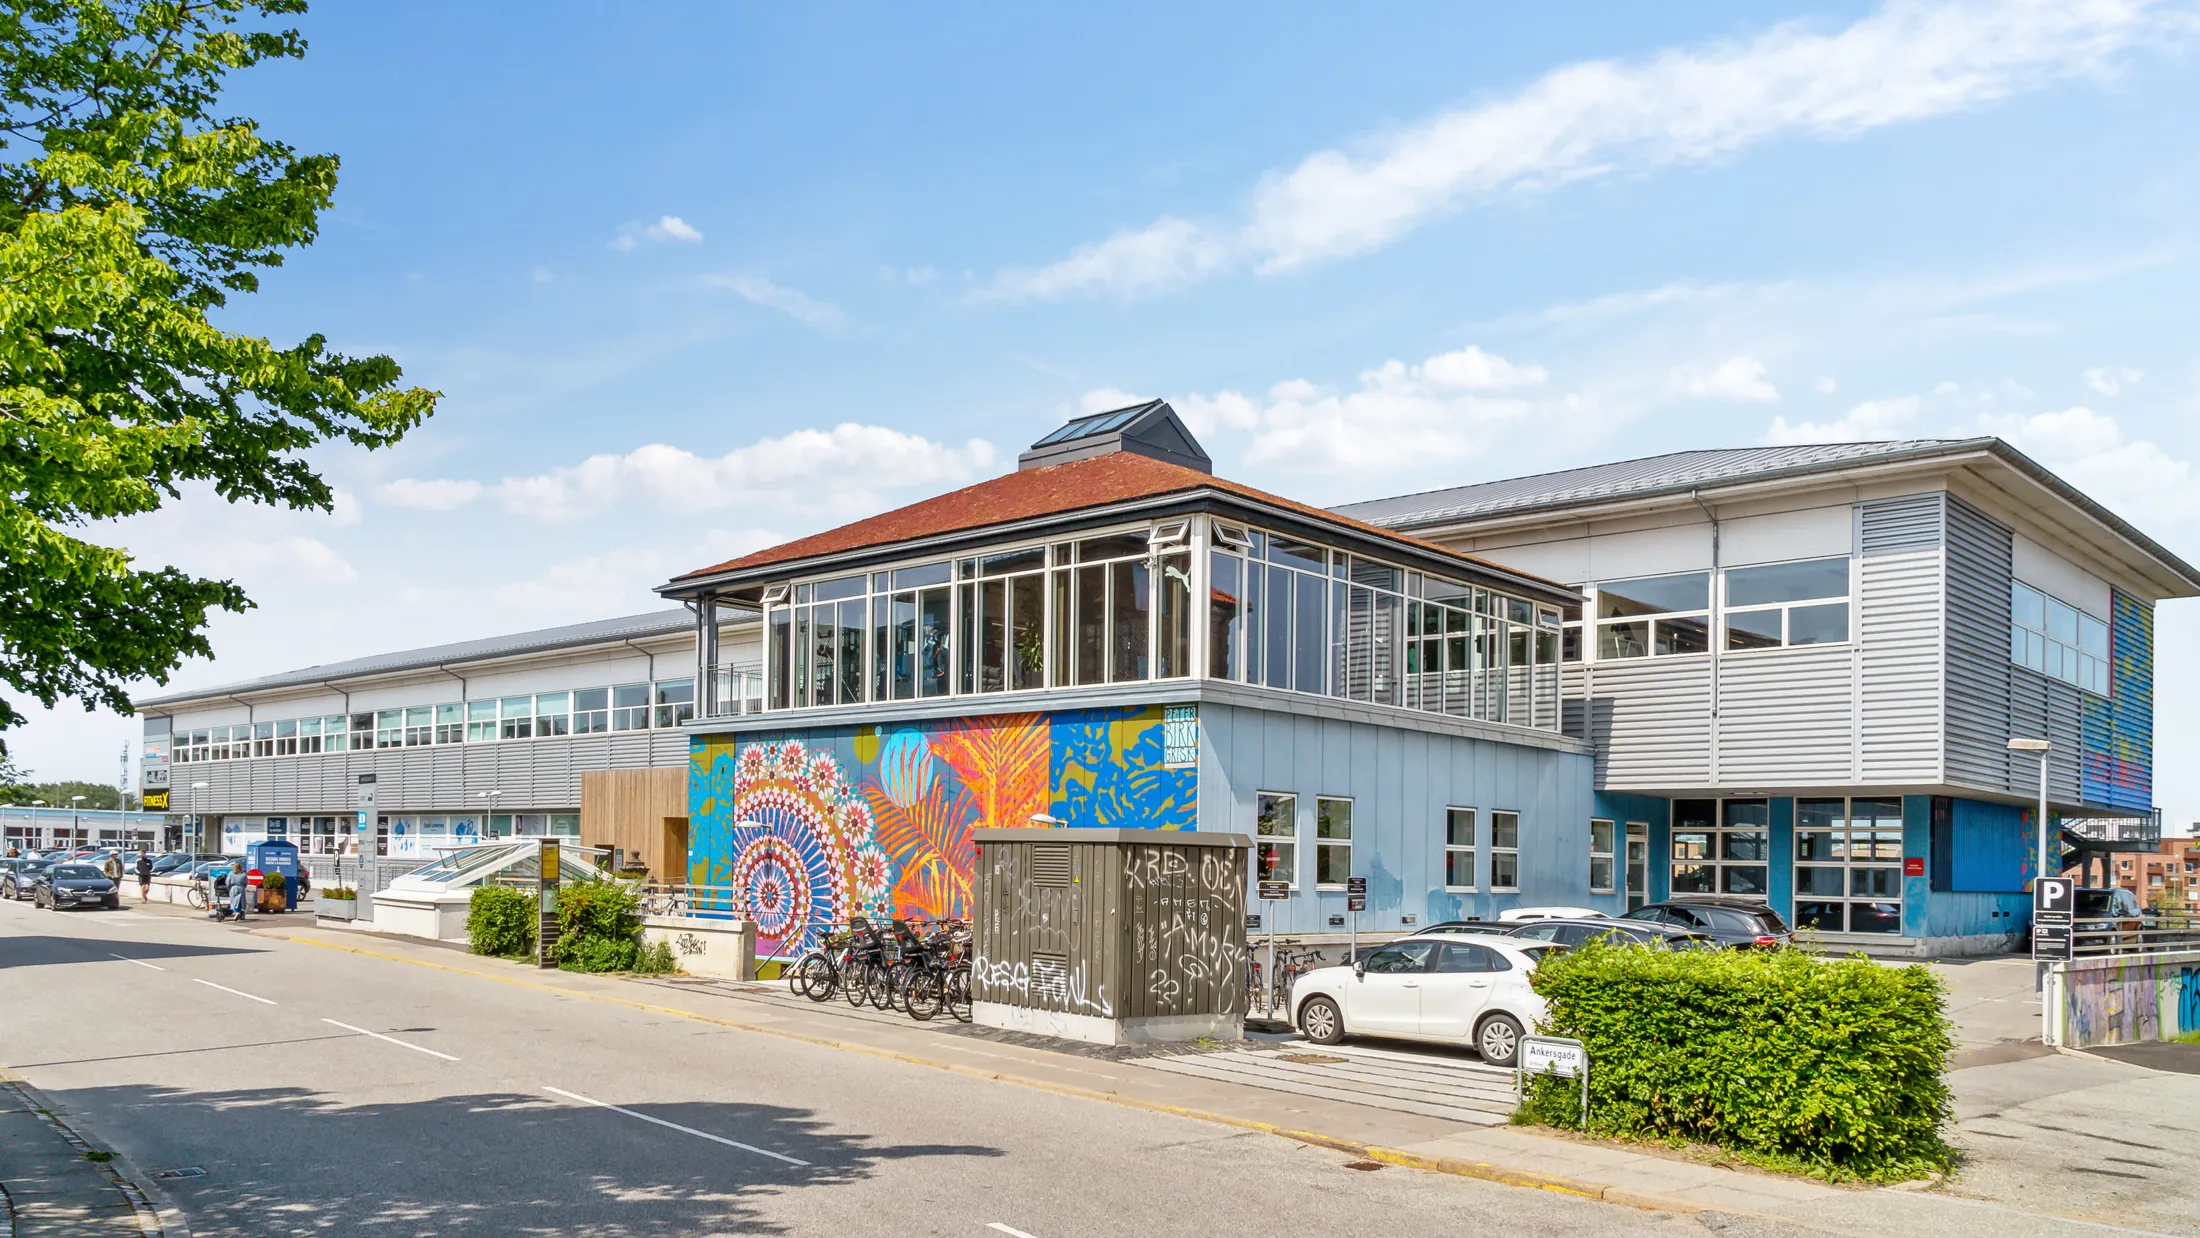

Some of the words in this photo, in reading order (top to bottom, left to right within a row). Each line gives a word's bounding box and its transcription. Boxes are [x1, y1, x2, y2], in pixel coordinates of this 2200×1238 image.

[1166, 707, 1195, 722] PETER
[1166, 722, 1195, 747] BIRK
[2043, 881, 2065, 909] P
[1530, 1046, 1576, 1061] Ankersgade
